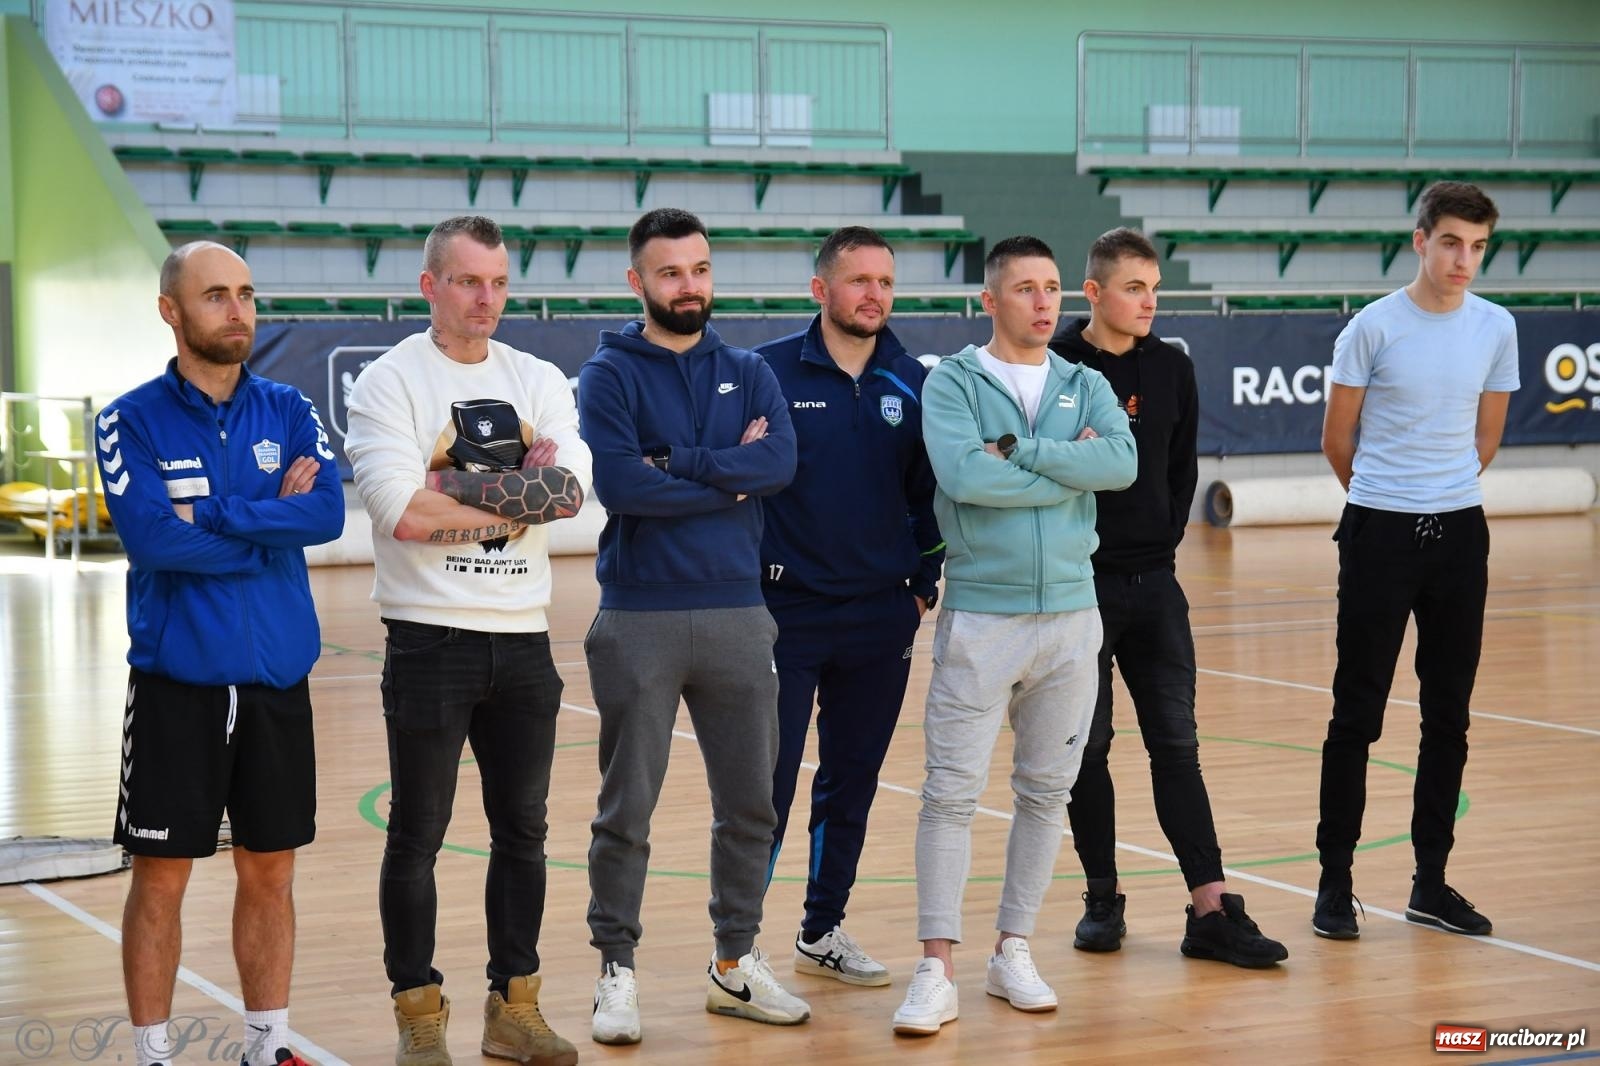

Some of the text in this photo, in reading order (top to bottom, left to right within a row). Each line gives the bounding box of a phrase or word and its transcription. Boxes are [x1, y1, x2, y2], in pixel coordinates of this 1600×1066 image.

[70, 0, 214, 31] MIESZKO
[157, 456, 203, 471] hummel
[446, 555, 472, 564] BEING
[769, 563, 784, 581] 17
[128, 822, 169, 840] hummel
